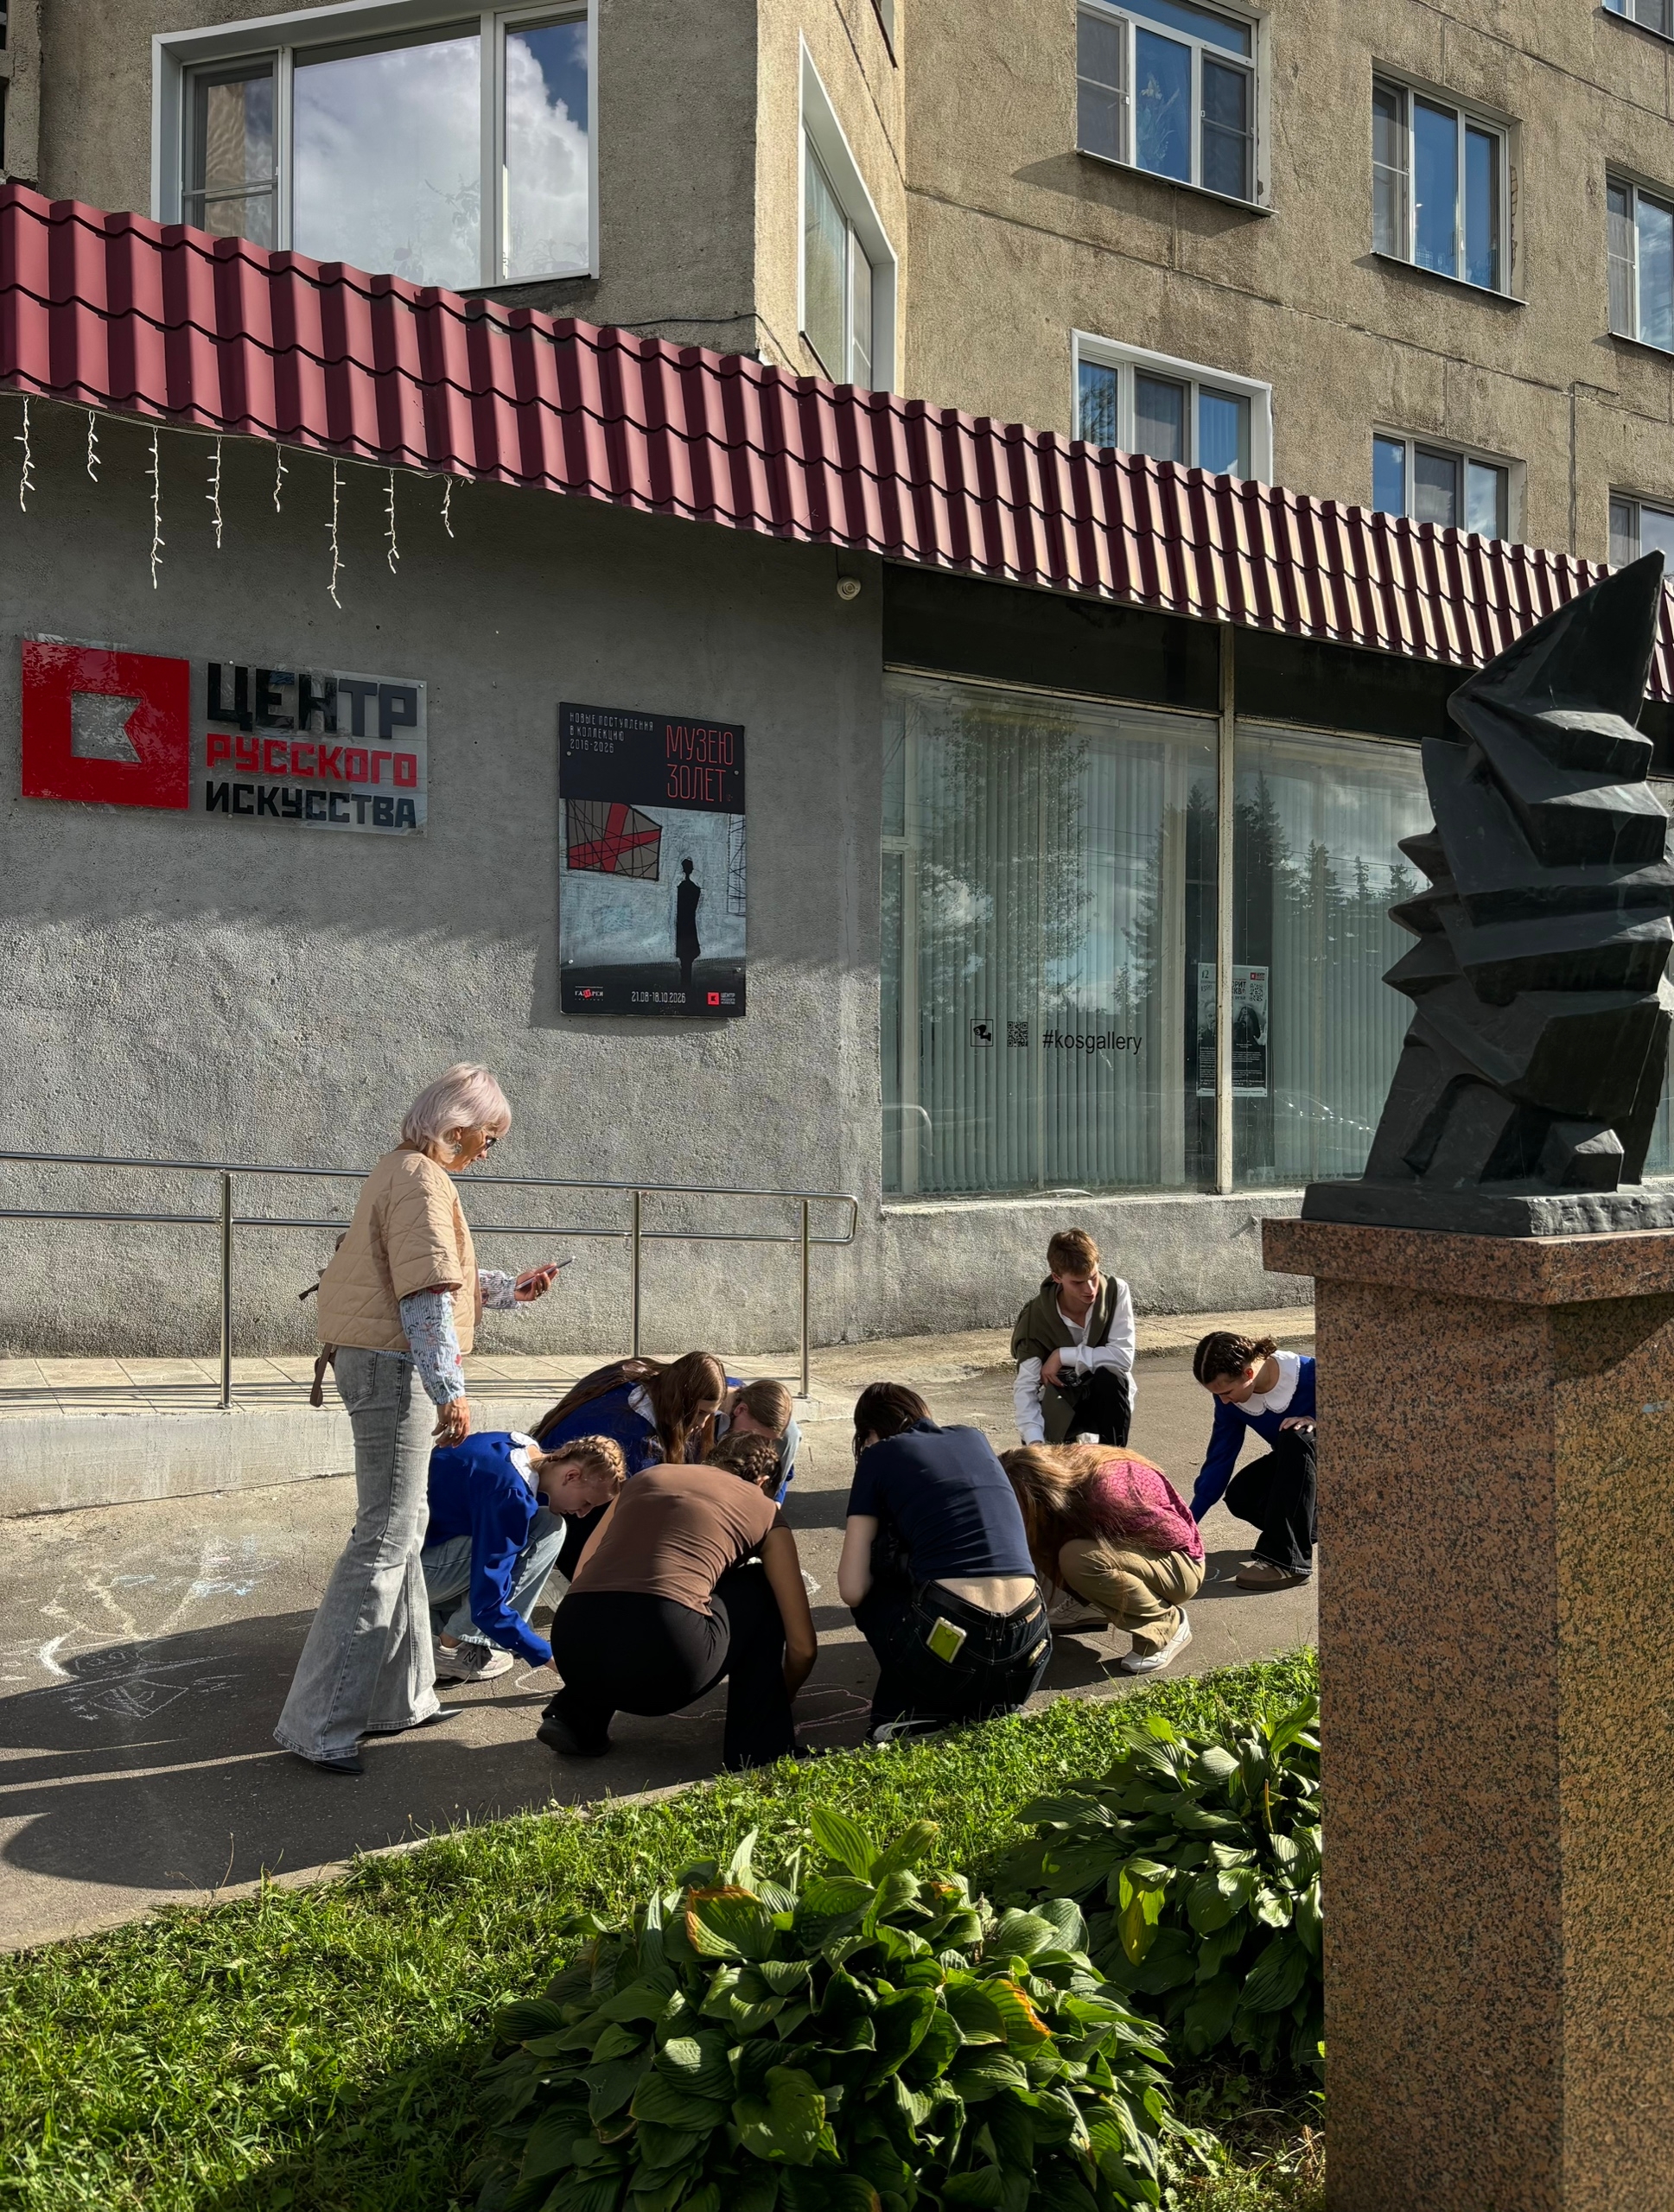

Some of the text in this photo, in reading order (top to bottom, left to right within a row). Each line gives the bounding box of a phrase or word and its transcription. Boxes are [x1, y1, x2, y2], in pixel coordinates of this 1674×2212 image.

[207, 662, 417, 740] ЦЕНТР
[570, 712, 654, 732] НОВЫЕ ПОСТУПЛЕНИЯ
[570, 725, 625, 741] В КОЛЛЕКЦИЮ
[206, 733, 417, 787] РУССКОГО
[570, 738, 614, 753] 2016-2026
[665, 724, 734, 766] МУЗЕЮ
[666, 763, 726, 803] ЗОЛЕТ
[206, 780, 417, 829] ИСКУССТВА
[1042, 1029, 1143, 1055] #kosgallery
